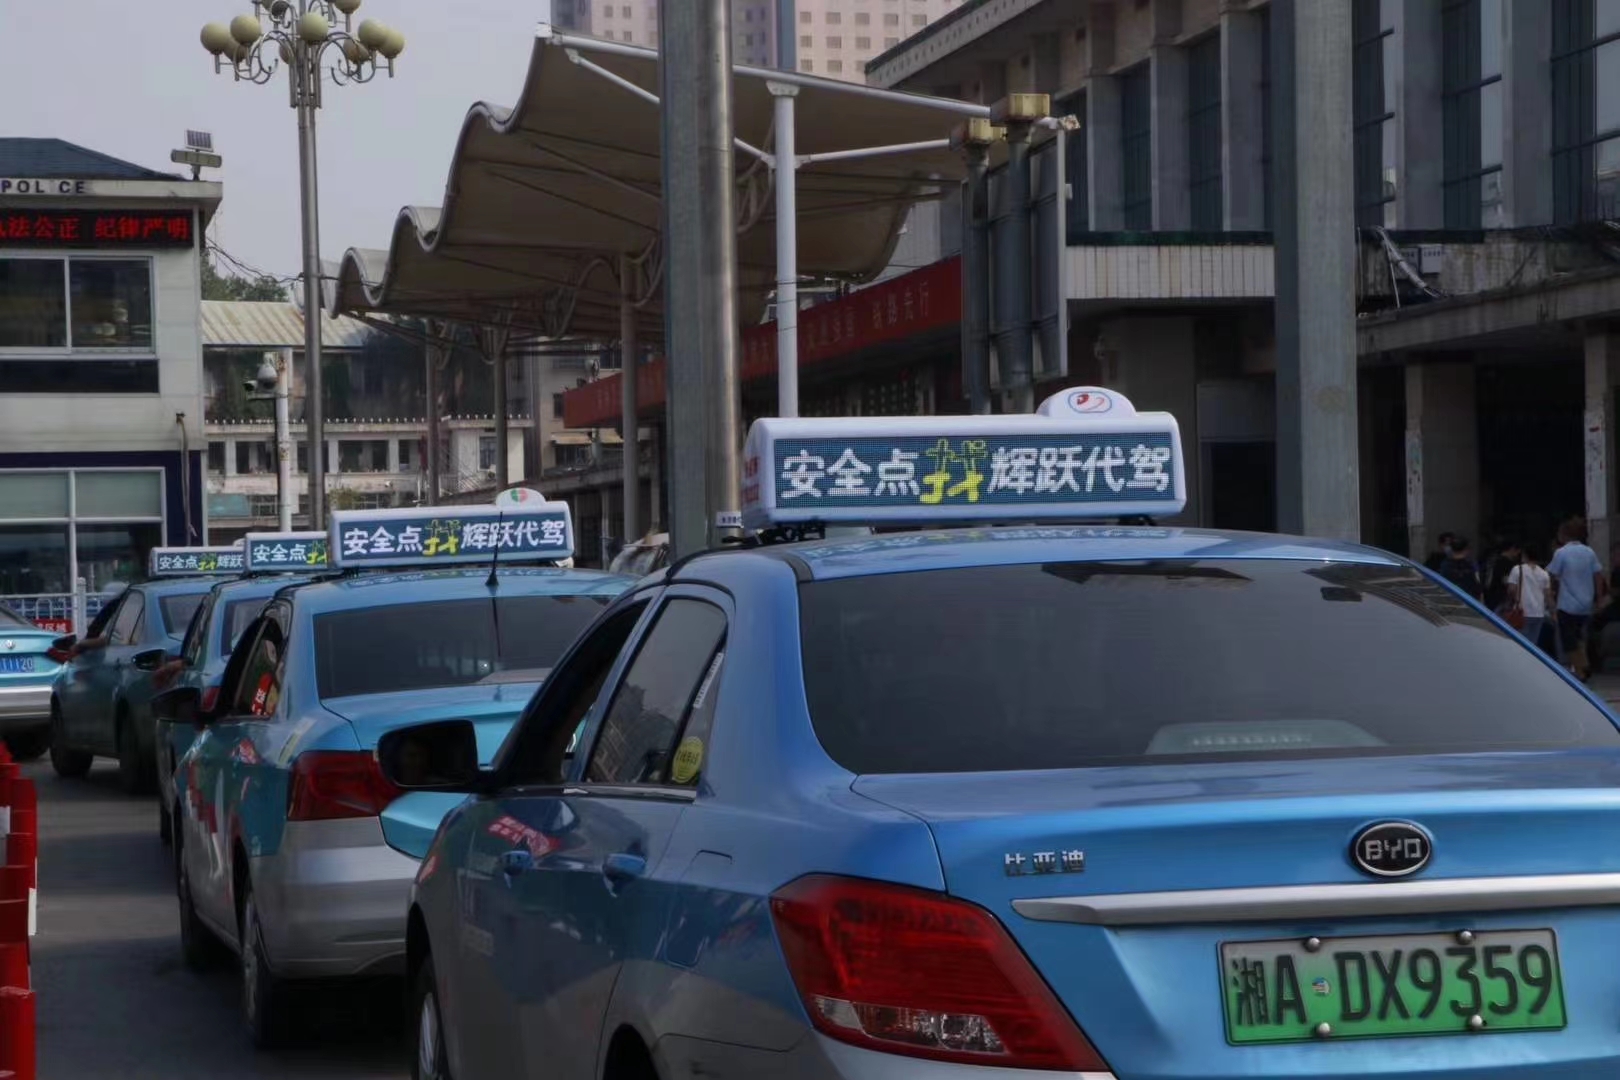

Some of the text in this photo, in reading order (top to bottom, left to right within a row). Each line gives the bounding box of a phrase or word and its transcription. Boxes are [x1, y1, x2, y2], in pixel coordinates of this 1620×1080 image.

[1, 179, 86, 193] POLCE
[95, 216, 189, 240] 纪律严明
[1364, 838, 1422, 861] BYD
[1004, 849, 1086, 876] 比亚迪
[1231, 944, 1552, 1026] 湘A DX9359
